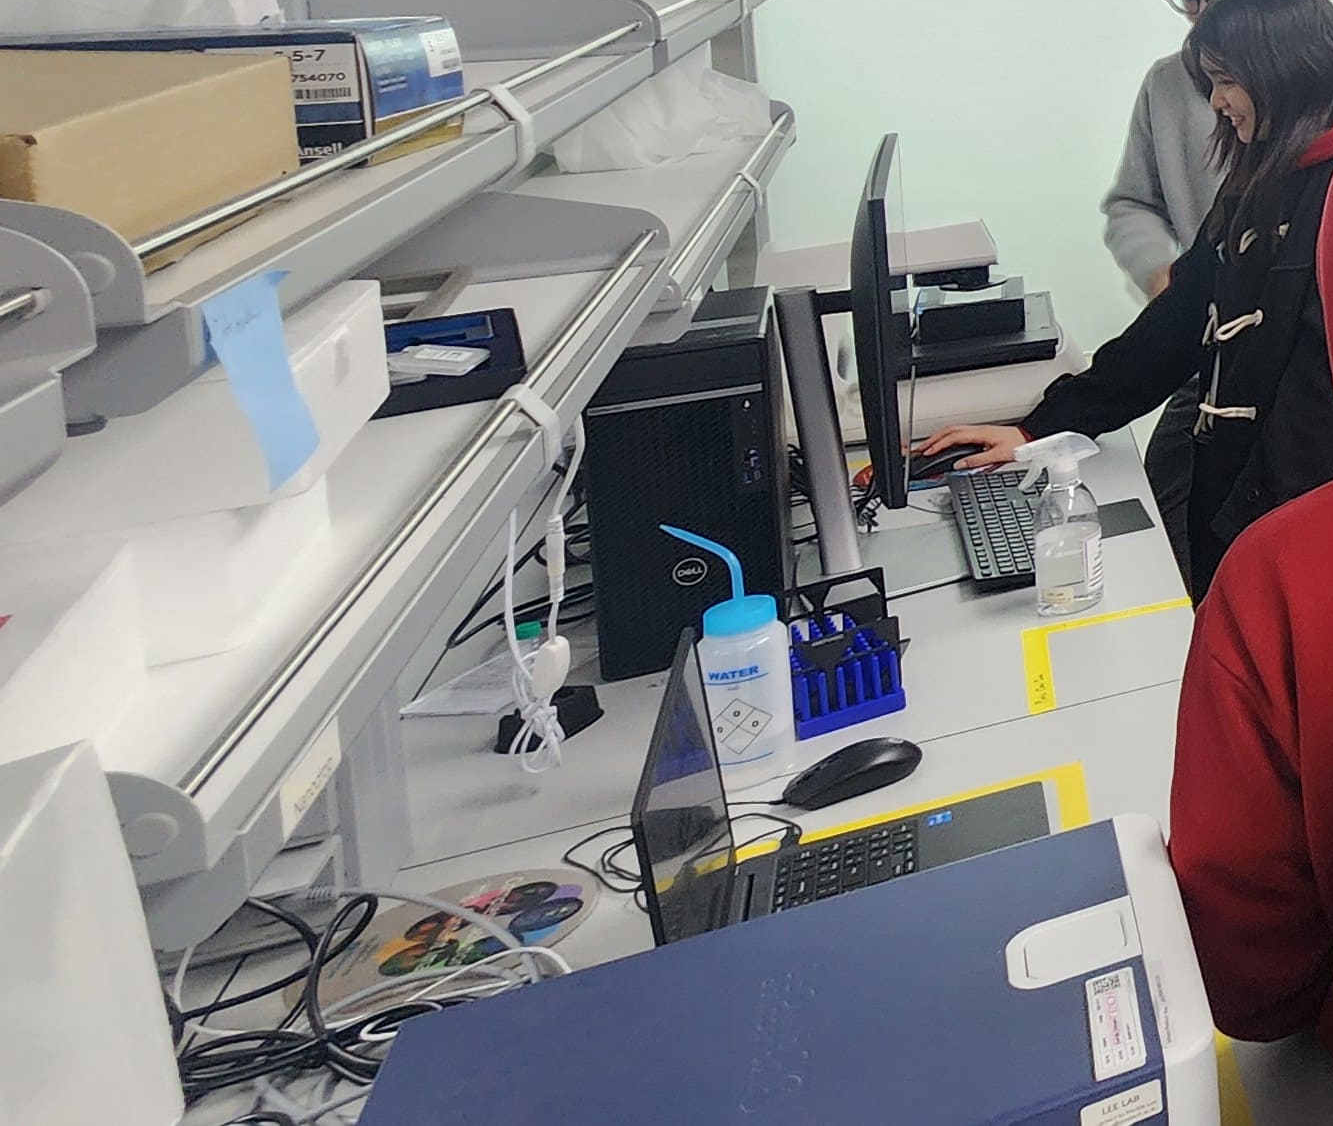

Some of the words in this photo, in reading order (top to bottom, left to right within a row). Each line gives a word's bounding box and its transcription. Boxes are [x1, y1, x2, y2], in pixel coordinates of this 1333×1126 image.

[274, 49, 326, 62] .5-7
[708, 665, 759, 682] WATER
[1102, 1103, 1118, 1115] LEE
